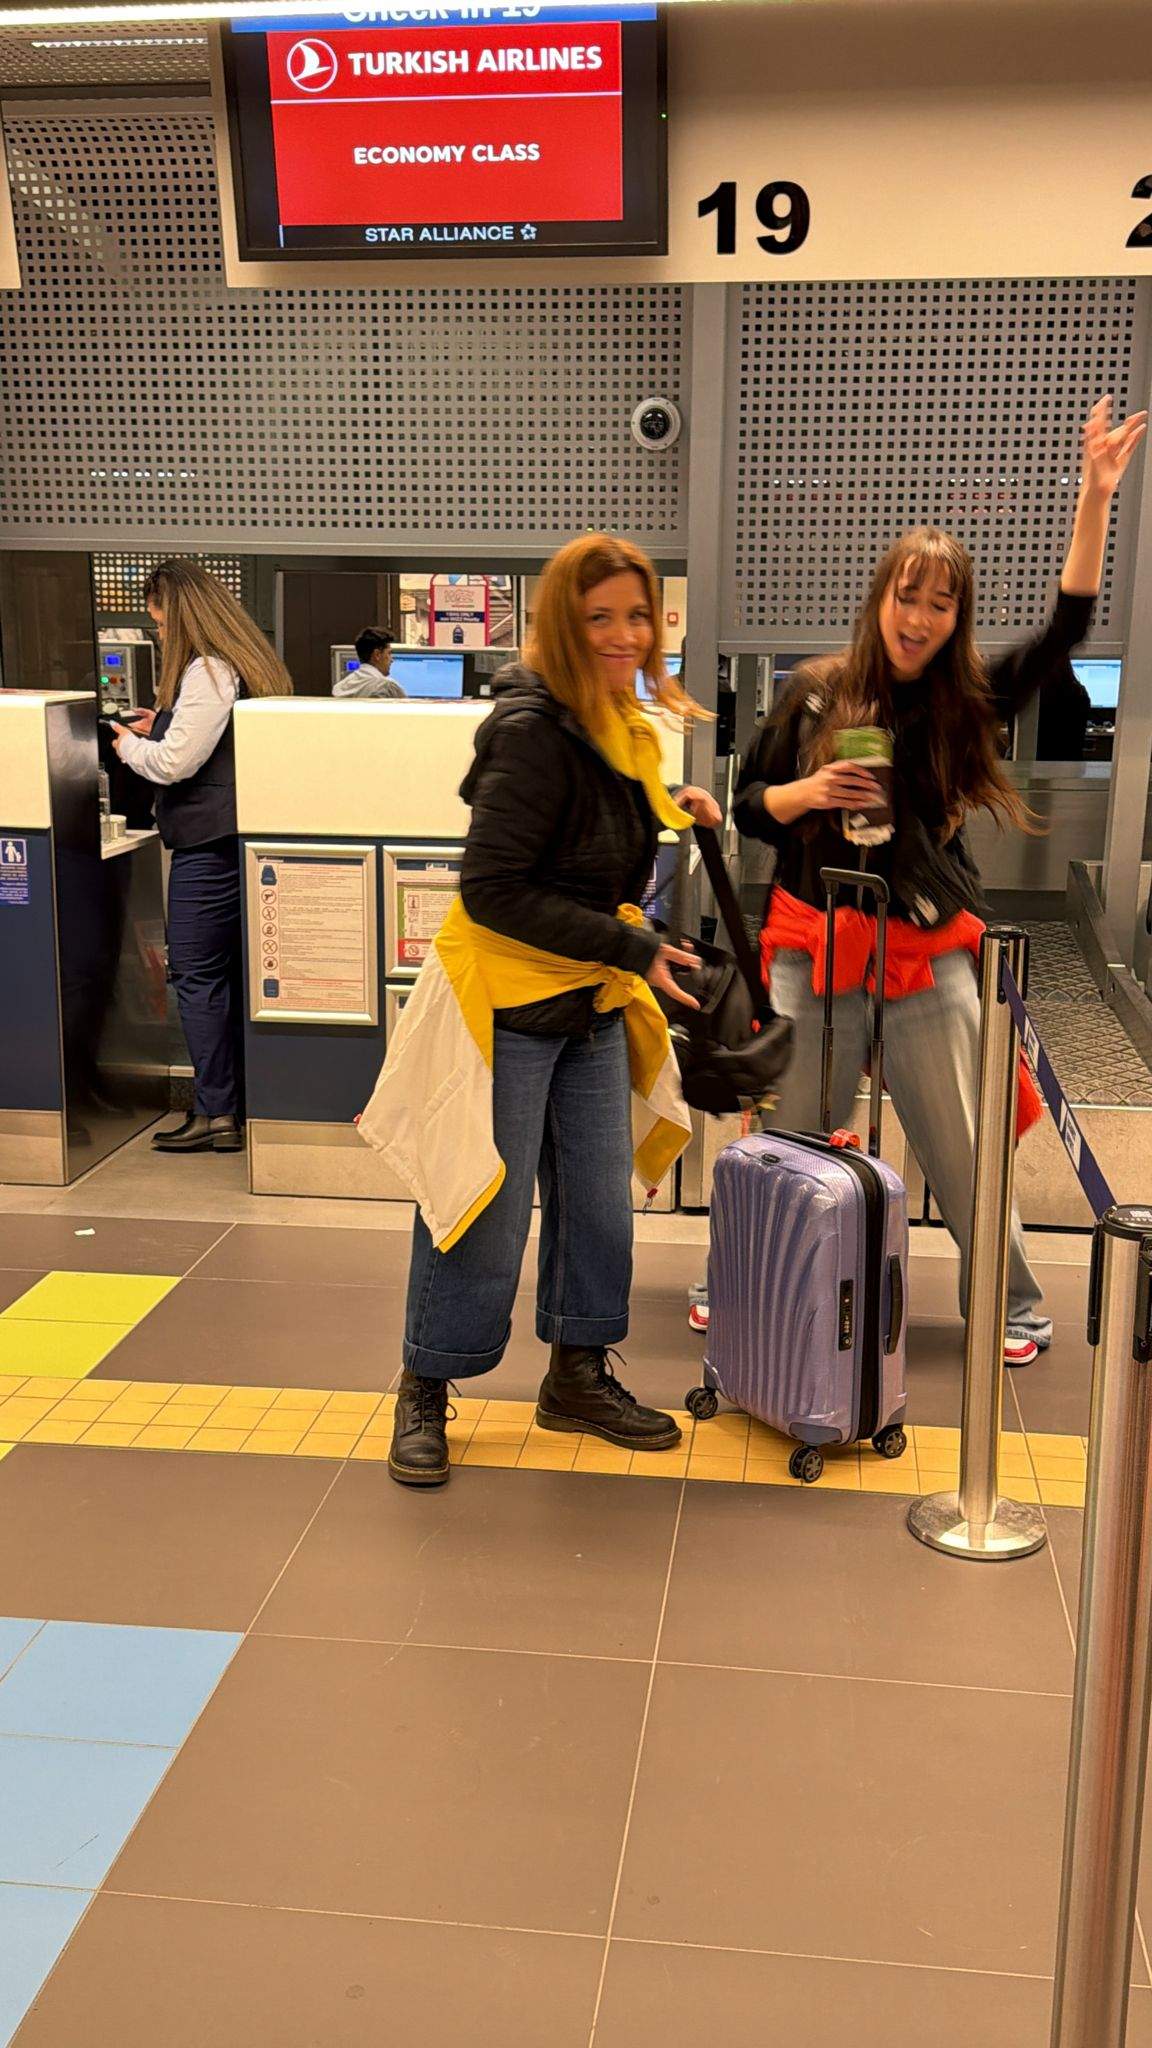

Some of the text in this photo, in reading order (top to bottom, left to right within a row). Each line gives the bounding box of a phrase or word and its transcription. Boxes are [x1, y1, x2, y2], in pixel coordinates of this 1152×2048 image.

[347, 46, 603, 76] TURKISH AIRLINES
[353, 143, 540, 164] ECONOMY CLASS
[697, 180, 811, 256] 19
[365, 224, 514, 242] STAR ALLIANCE
